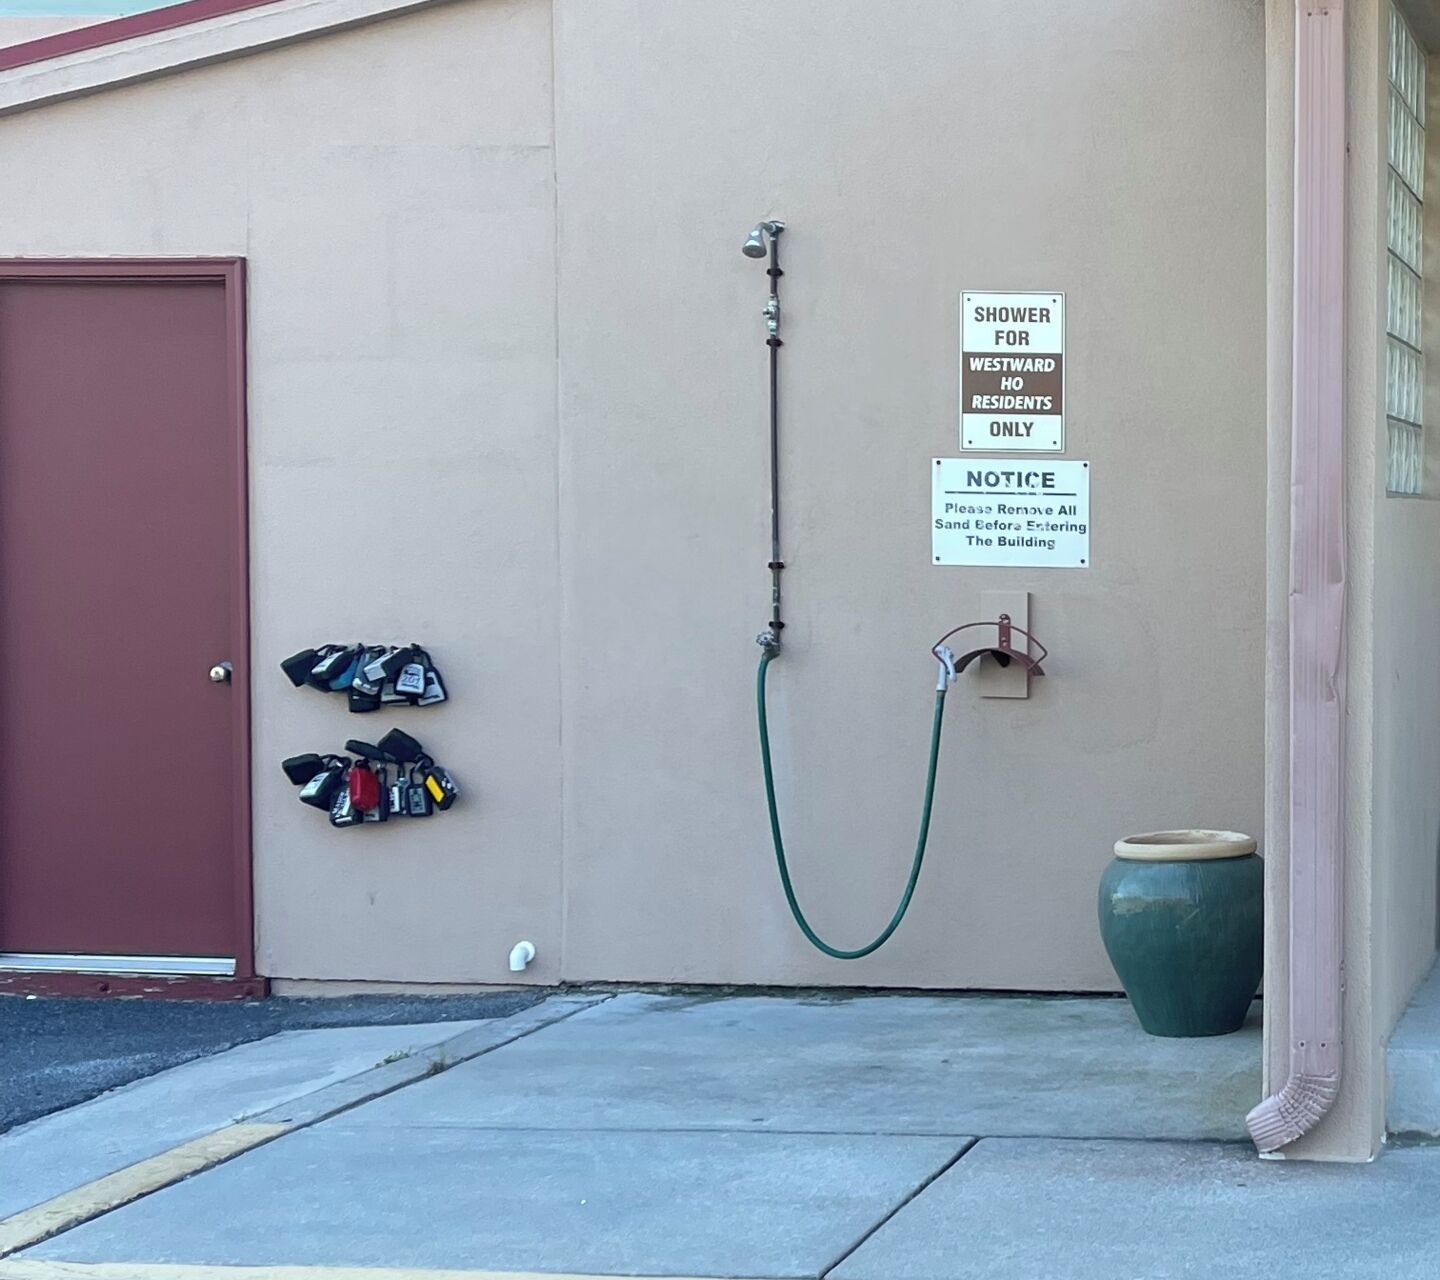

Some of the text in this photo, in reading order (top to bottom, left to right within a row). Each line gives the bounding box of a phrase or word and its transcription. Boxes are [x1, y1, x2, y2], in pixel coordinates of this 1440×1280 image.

[974, 306, 1051, 323] SHOWER
[994, 330, 1030, 346] FOR
[969, 357, 1056, 373] WESTWARD
[1000, 376, 1024, 391] HO
[971, 395, 1052, 410] RESIDENTS
[989, 421, 1034, 437] ONLY
[966, 470, 1055, 488] NOTICE
[945, 503, 1077, 516] Please Remove All
[934, 519, 1087, 535] Sand Before Entering
[965, 535, 1055, 550] The Building
